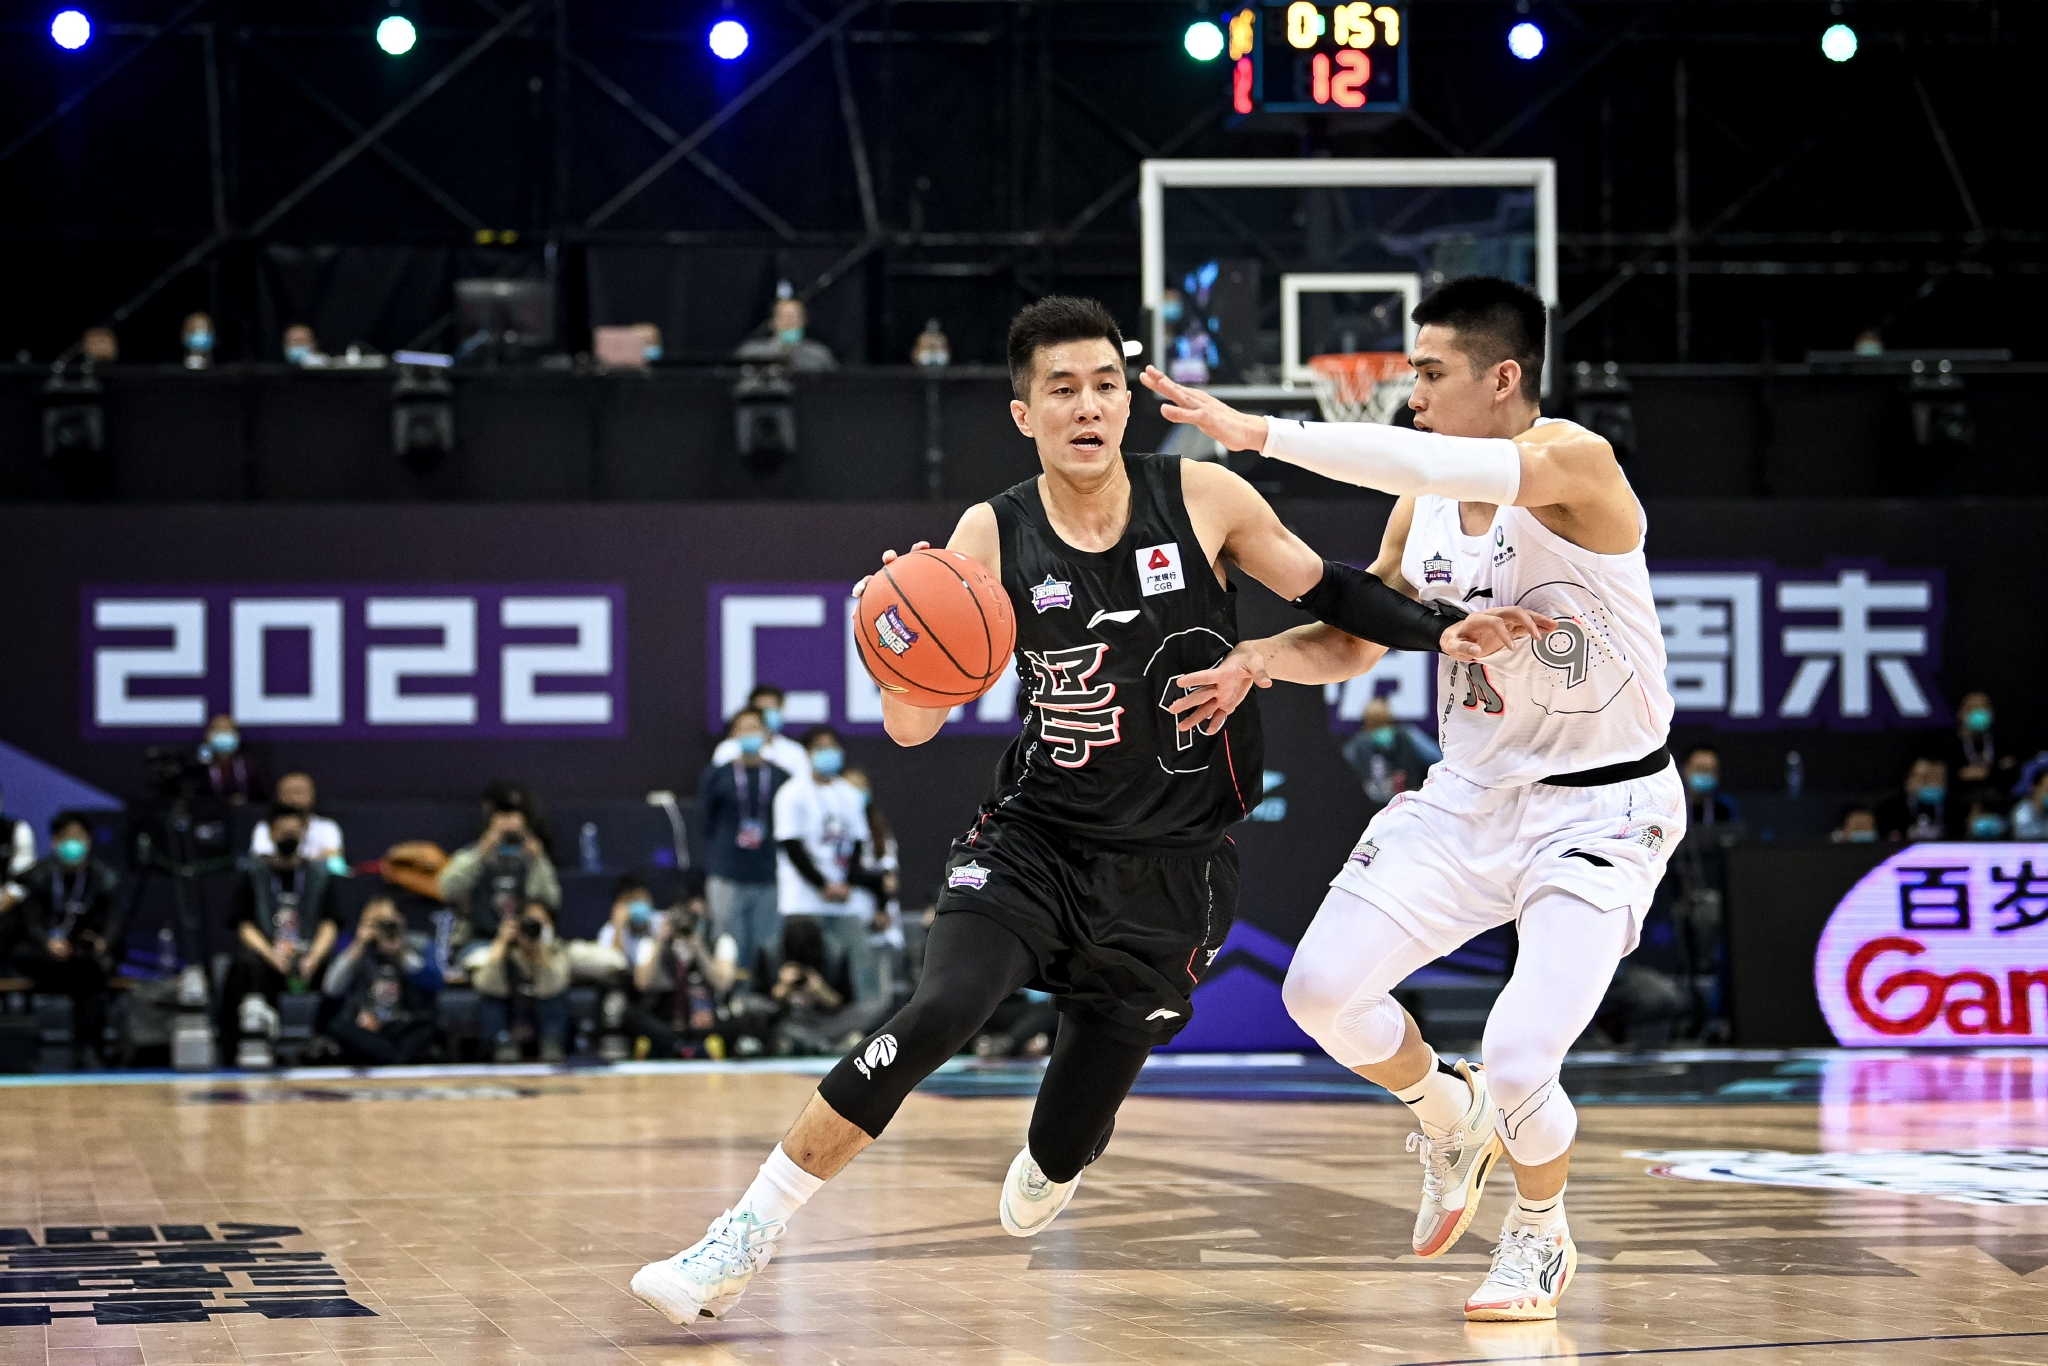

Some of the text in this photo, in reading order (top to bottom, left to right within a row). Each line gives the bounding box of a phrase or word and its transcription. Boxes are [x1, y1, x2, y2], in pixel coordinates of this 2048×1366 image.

[1312, 50, 1370, 108] 12
[1154, 581, 1173, 592] CGB
[94, 598, 612, 727] 2022
[1532, 616, 1590, 690] 9
